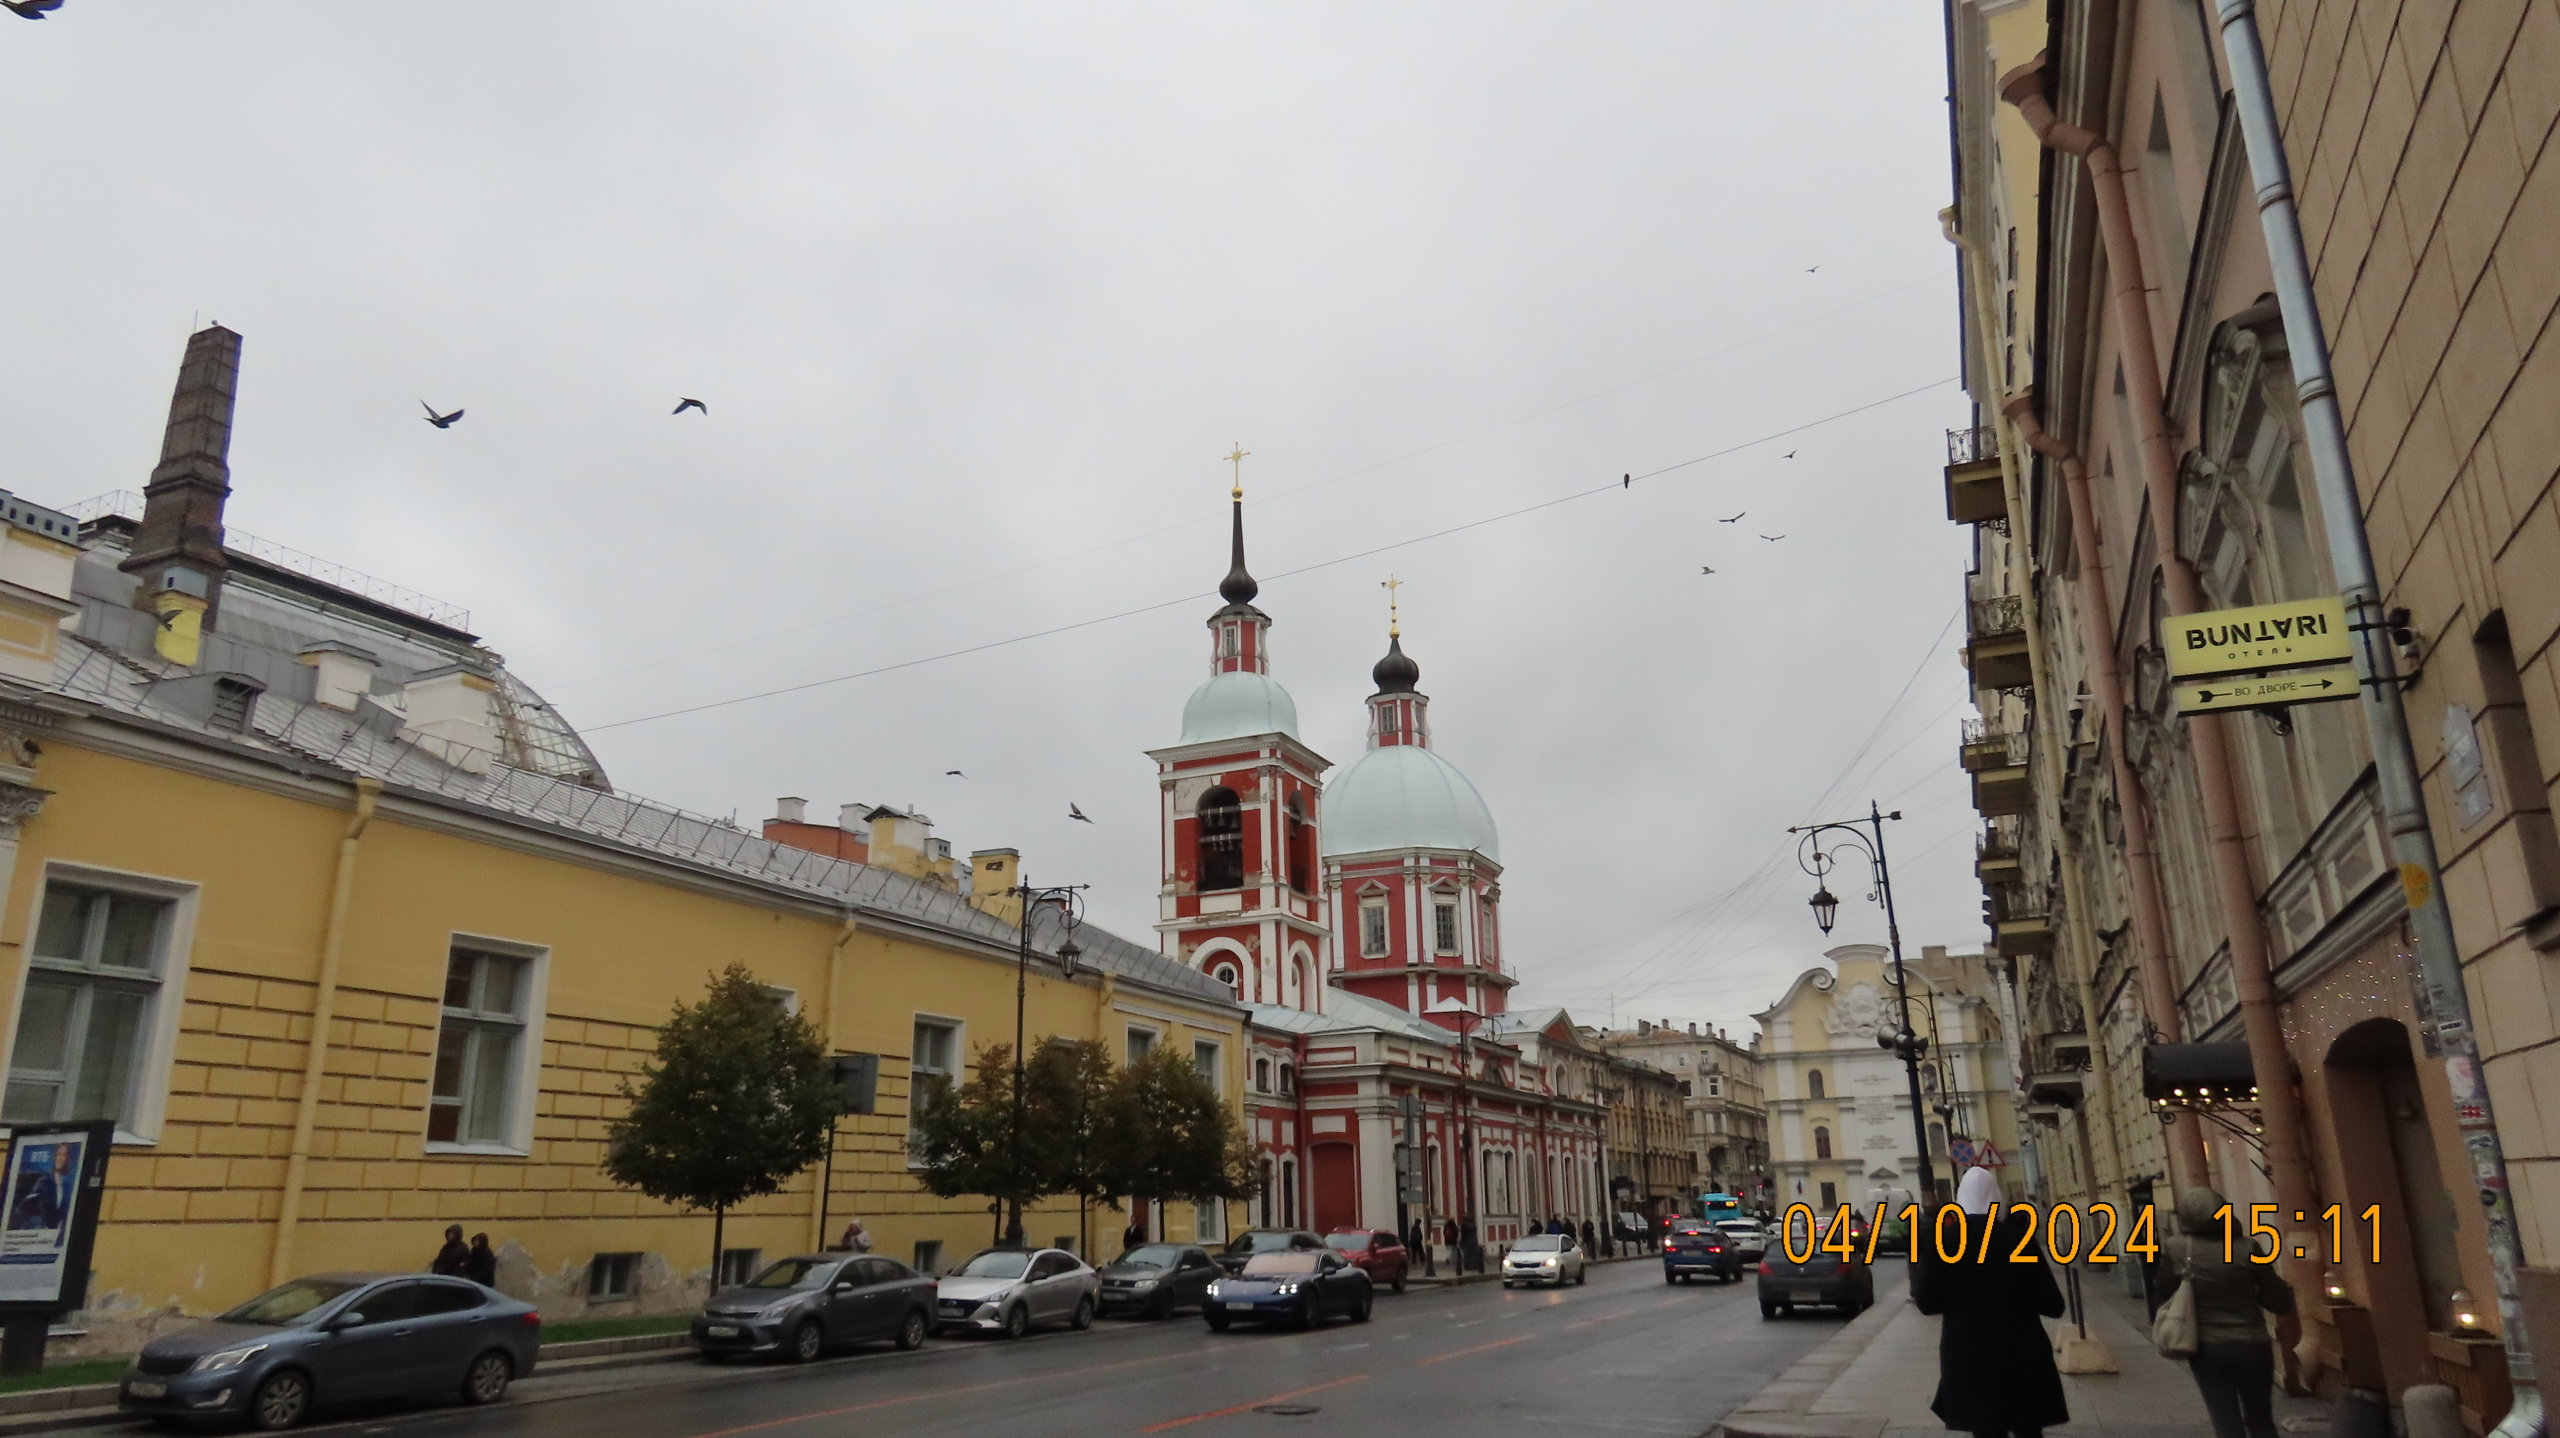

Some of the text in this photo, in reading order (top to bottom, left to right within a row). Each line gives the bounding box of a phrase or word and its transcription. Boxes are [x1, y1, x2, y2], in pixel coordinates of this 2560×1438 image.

[2185, 613, 2328, 650] BUNTARI
[2228, 646, 2292, 660] ОТЕЛЬ
[2234, 682, 2298, 697] ВО ДВОРЕ
